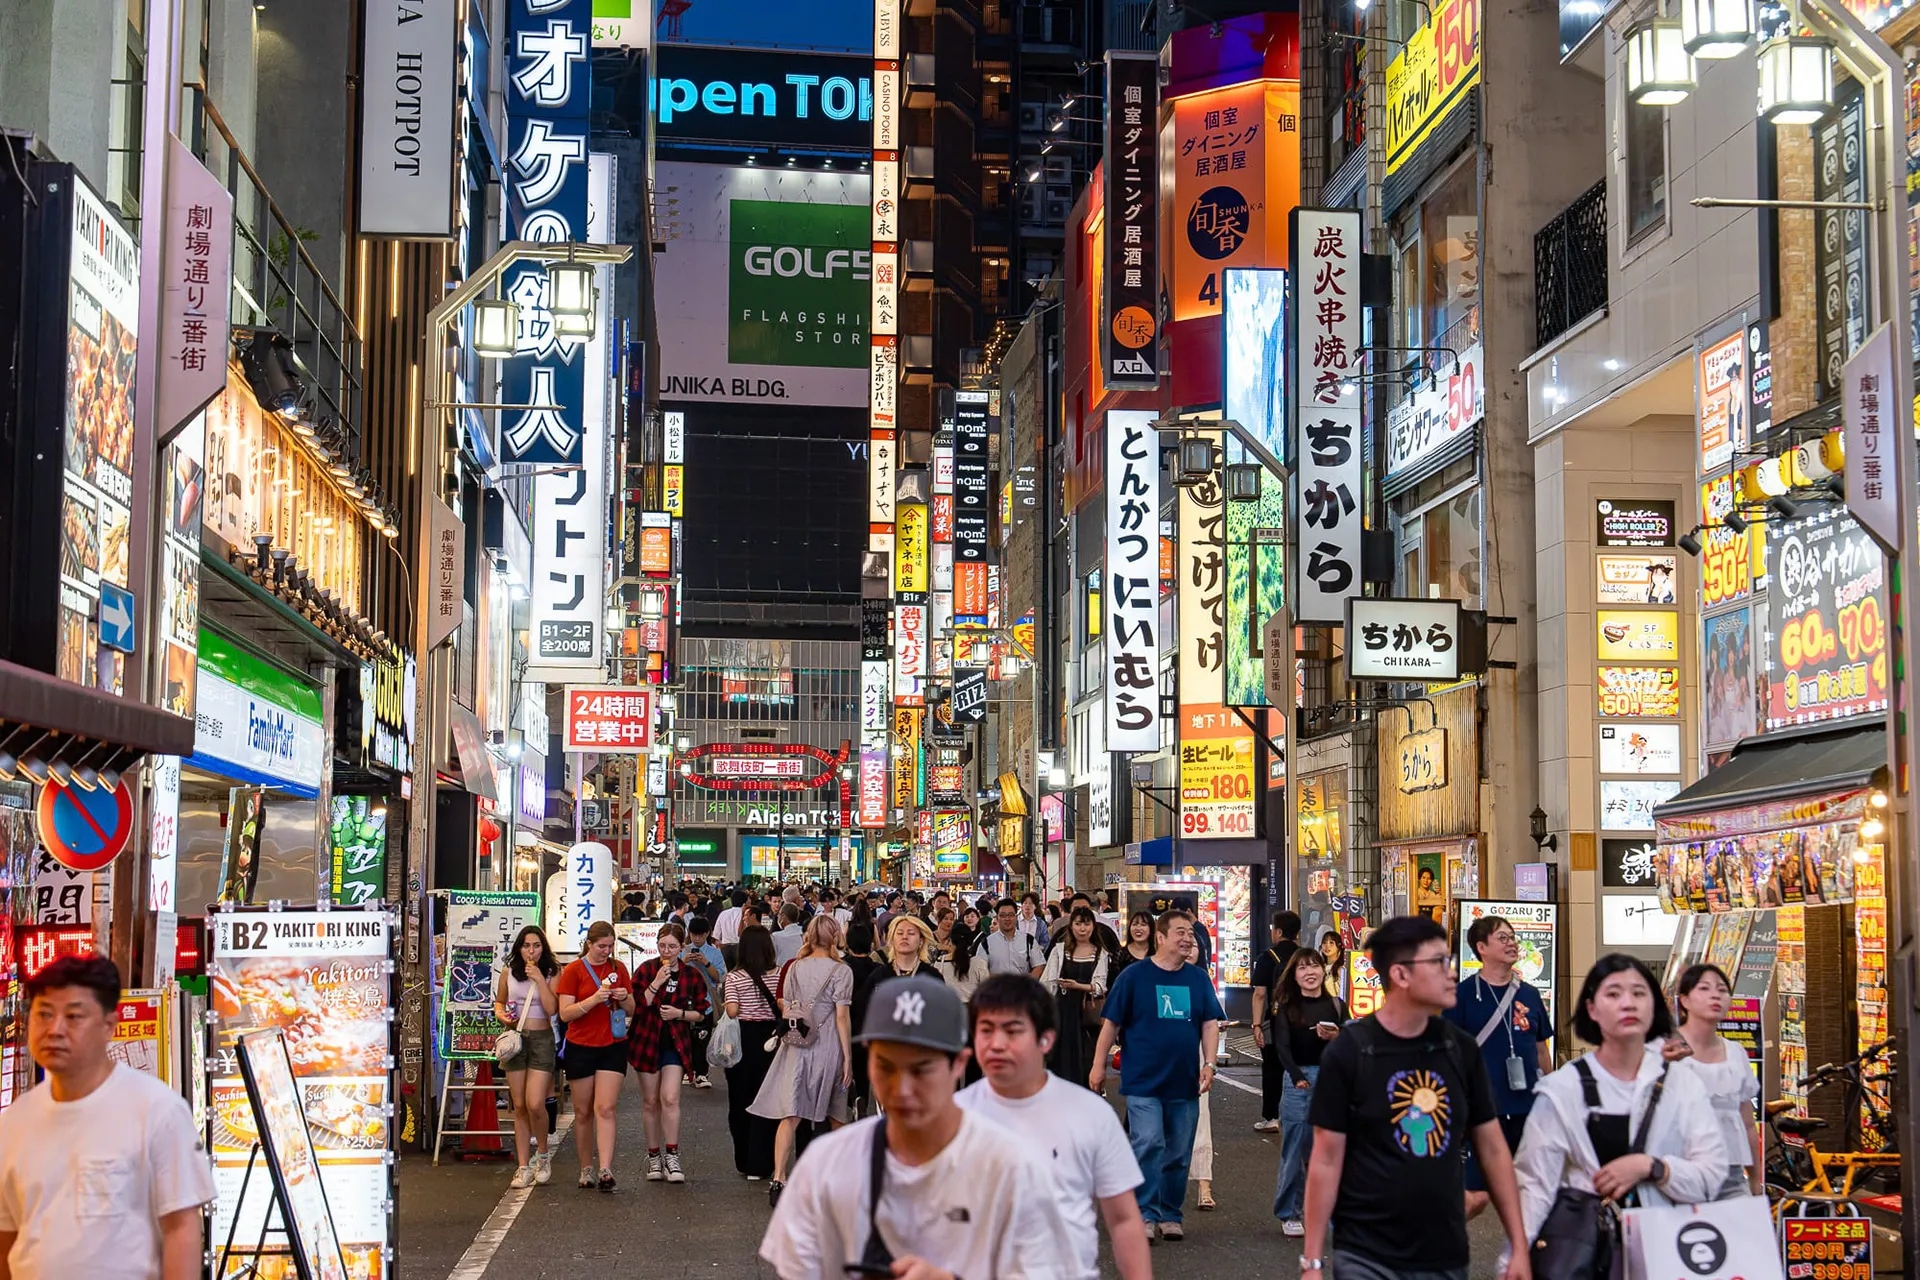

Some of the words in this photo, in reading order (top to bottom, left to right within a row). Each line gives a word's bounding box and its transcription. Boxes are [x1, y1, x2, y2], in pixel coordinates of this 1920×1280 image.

[880, 9, 891, 47] ABYSS
[890, 62, 897, 70] 9
[655, 78, 777, 124] pen
[882, 75, 891, 113] CASINO
[394, 52, 424, 176] HOTPOT
[1203, 106, 1239, 131] 個室
[1388, 69, 1432, 150] ハイボール
[881, 115, 890, 146] POKER
[1181, 124, 1260, 157] ダイニング
[889, 153, 896, 161] 8
[1195, 149, 1248, 178] 居酒屋
[1123, 84, 1144, 288] 個室ダイニング居酒屋
[1218, 201, 1264, 218] SHUNKA
[75, 191, 113, 267] YAKITORI
[114, 234, 133, 287] KING
[1188, 199, 1249, 252] 旬香
[180, 204, 213, 372] 劇場通り一番街
[1198, 272, 1219, 306] 4
[1312, 226, 1348, 405] 炭火串焼き
[888, 337, 894, 346] 6
[1116, 359, 1144, 375] 入口
[731, 378, 790, 399] BLDG.
[668, 415, 680, 461] 小松ビル
[887, 432, 894, 440] 5
[1859, 373, 1883, 500] 劇場通り一番街
[1118, 427, 1151, 563] とんかつ
[1303, 418, 1356, 593] ちから
[1609, 522, 1628, 531] HIGH
[1629, 522, 1656, 531] ROLLER
[901, 524, 915, 588] ヤマネ肉店
[439, 529, 455, 617] 劇場通り一番街
[541, 638, 592, 653] 全200席
[1361, 622, 1454, 652] ちから
[866, 649, 884, 658] 3F
[1113, 573, 1156, 730] にいむら
[1270, 629, 1282, 692] 劇場通り一番街
[1383, 657, 1432, 668] CHIKARA
[575, 695, 645, 719] 24時間
[902, 696, 918, 706] 4F
[957, 685, 986, 712] RIZ
[248, 701, 295, 767] FamilyMart
[574, 721, 644, 744] 営業中
[715, 760, 801, 774] 歌舞伎町一番街
[1182, 745, 1234, 763] 生ビール
[1402, 744, 1432, 783] ちから
[863, 759, 884, 822] 安楽亭
[746, 808, 807, 829] Alpen
[937, 811, 964, 828] キラリ
[937, 820, 969, 848] 出会い
[949, 837, 970, 853] カフェ
[455, 895, 481, 905] COCO's
[481, 895, 505, 905] SHISHA
[506, 896, 533, 906] Terrace
[576, 853, 596, 936] カラオケ
[499, 917, 523, 931] 2F
[1490, 906, 1533, 916] GOZARU
[1535, 908, 1551, 922] 3F
[232, 921, 268, 950] B2
[273, 922, 341, 938] YAKITORI
[345, 922, 381, 937] KING
[303, 961, 381, 986] Yakitori
[321, 987, 383, 1009] 焼き鳥
[892, 990, 927, 1026] NY
[121, 1005, 137, 1020] 告
[1790, 1221, 1866, 1239] フード全品
[1787, 1242, 1845, 1260] 299円
[1813, 1263, 1870, 1280] 399円
